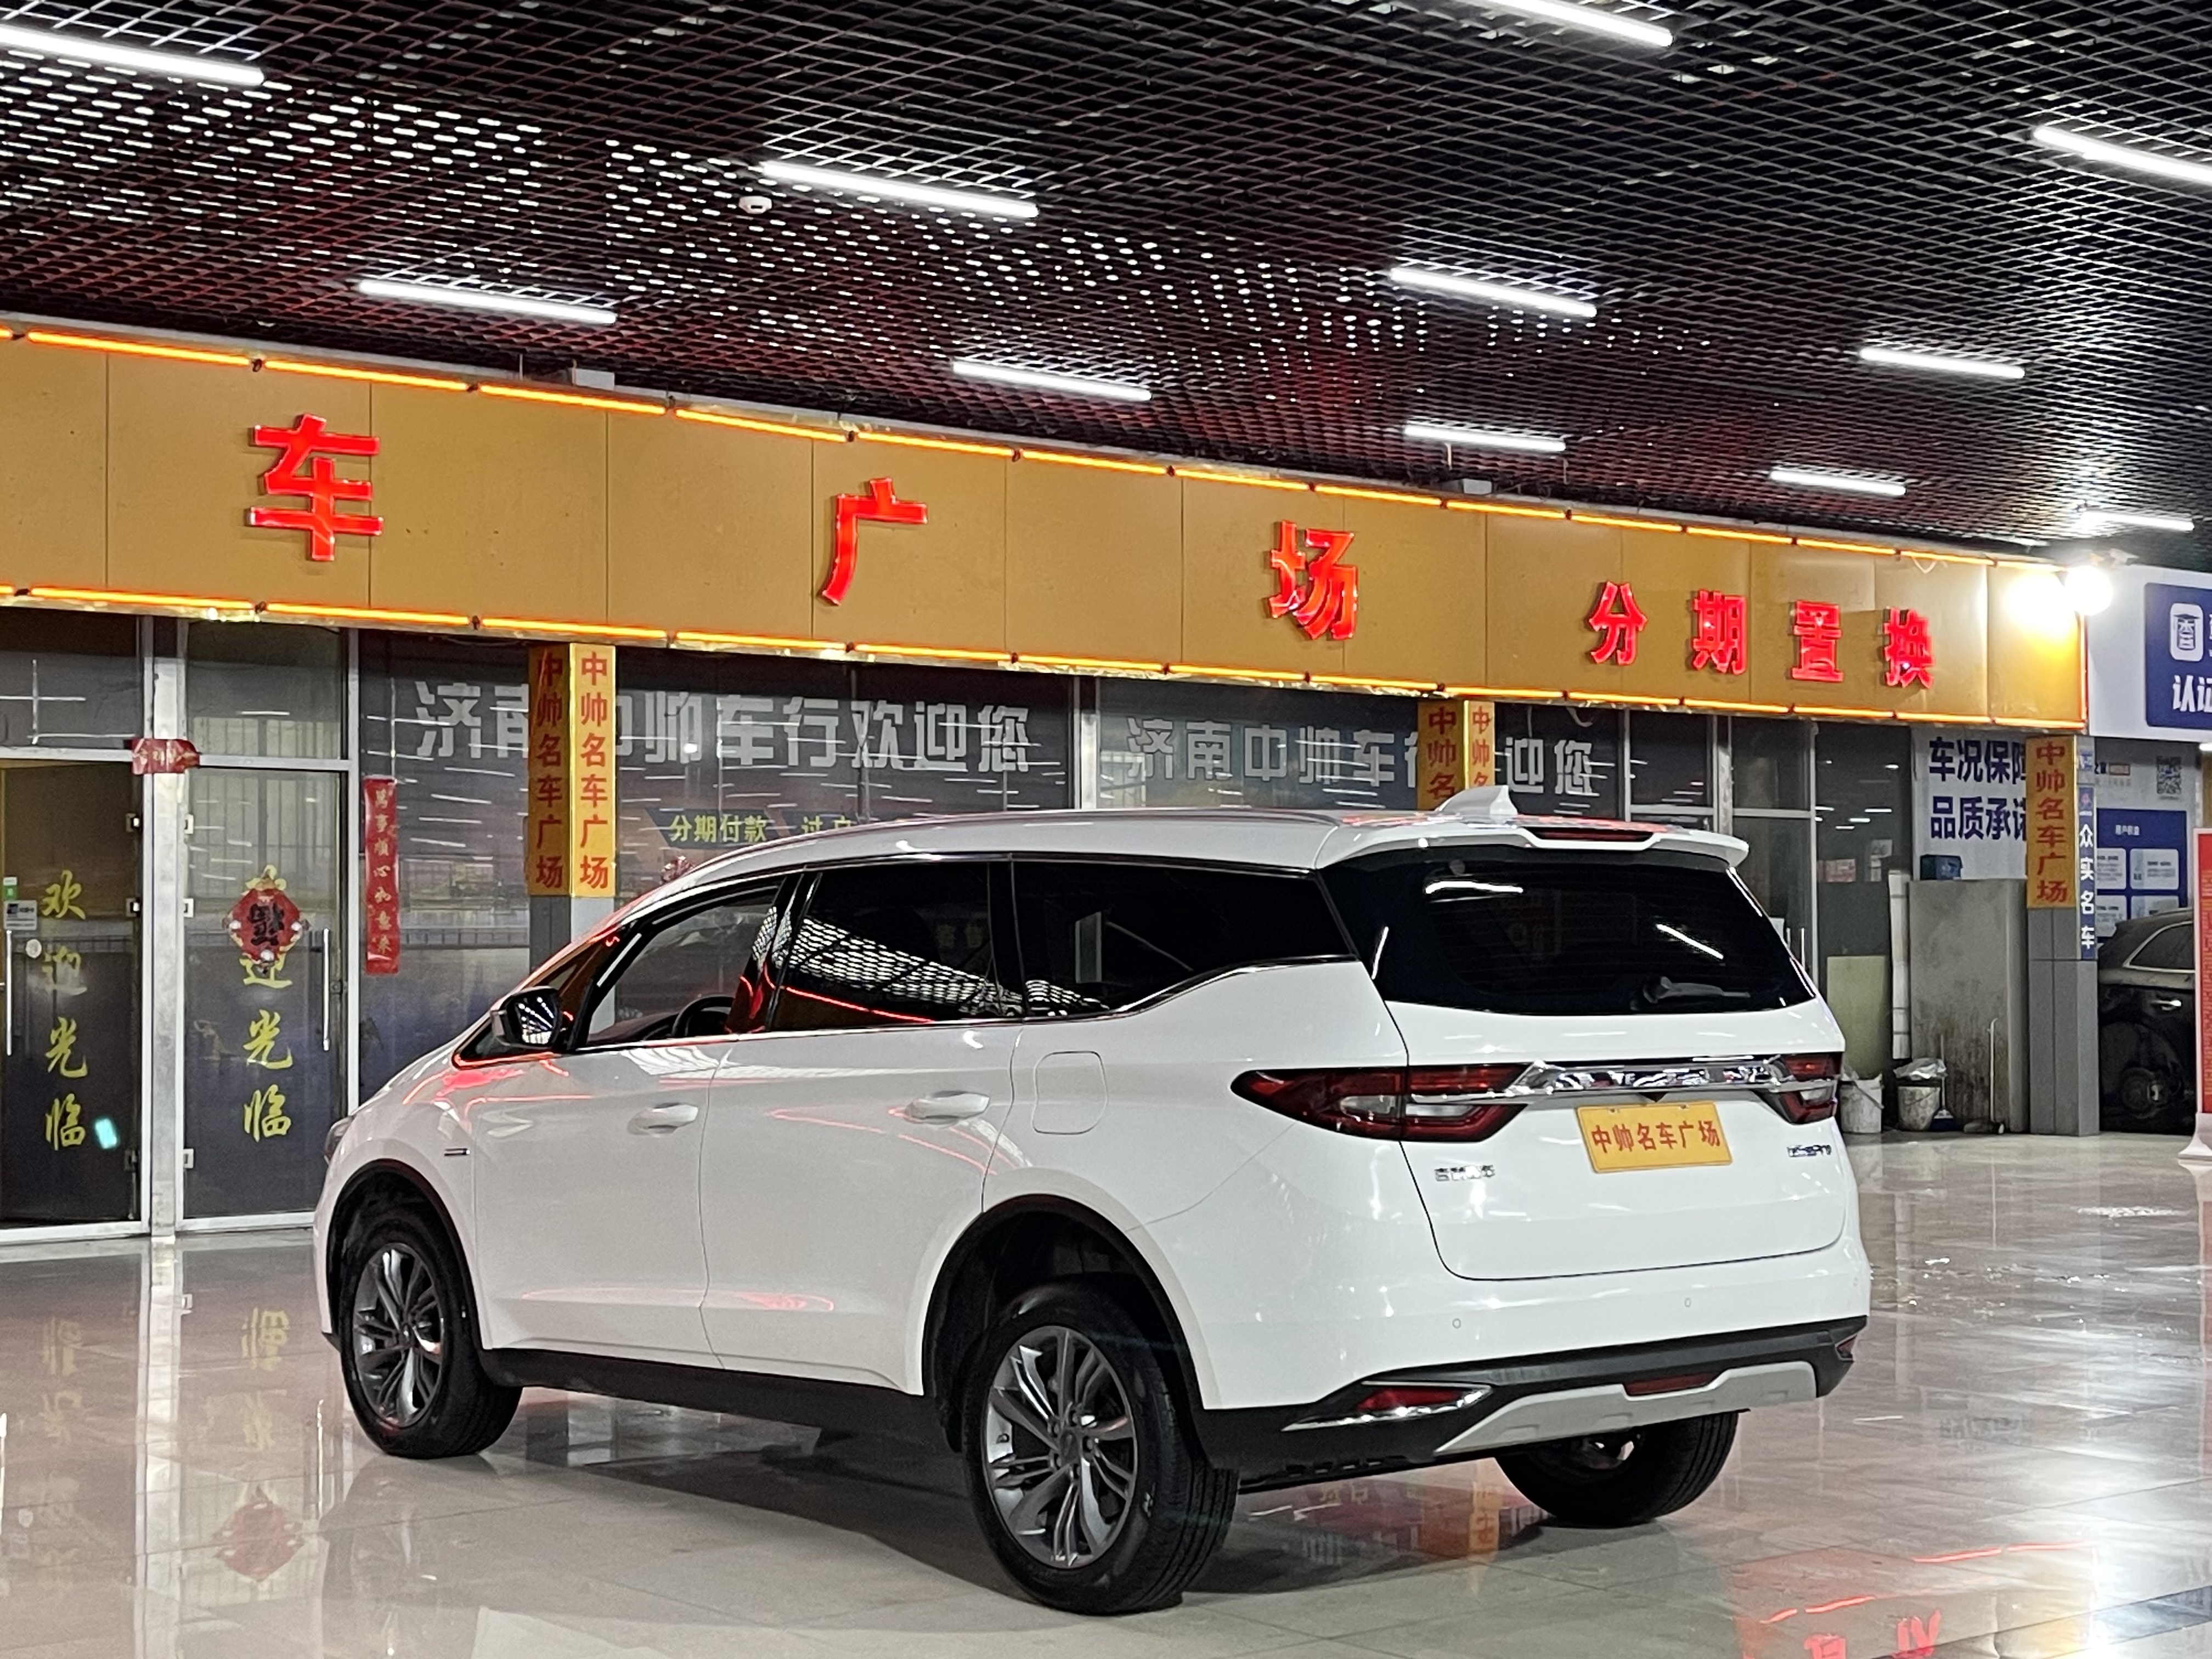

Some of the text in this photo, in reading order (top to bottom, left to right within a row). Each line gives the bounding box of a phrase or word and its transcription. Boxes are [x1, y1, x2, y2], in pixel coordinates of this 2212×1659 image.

[1589, 580, 1934, 689] 分期置换
[415, 681, 1030, 773] 济南帅车行欢迎您
[536, 652, 563, 889] 中帅名车广场
[580, 651, 608, 889] 中帅名车广场
[669, 815, 768, 844] 分期付款
[2035, 741, 2068, 903] 中帅名车广场
[41, 869, 88, 1151] 欢迎光临
[1591, 1120, 1722, 1155] 中帅名车广场
